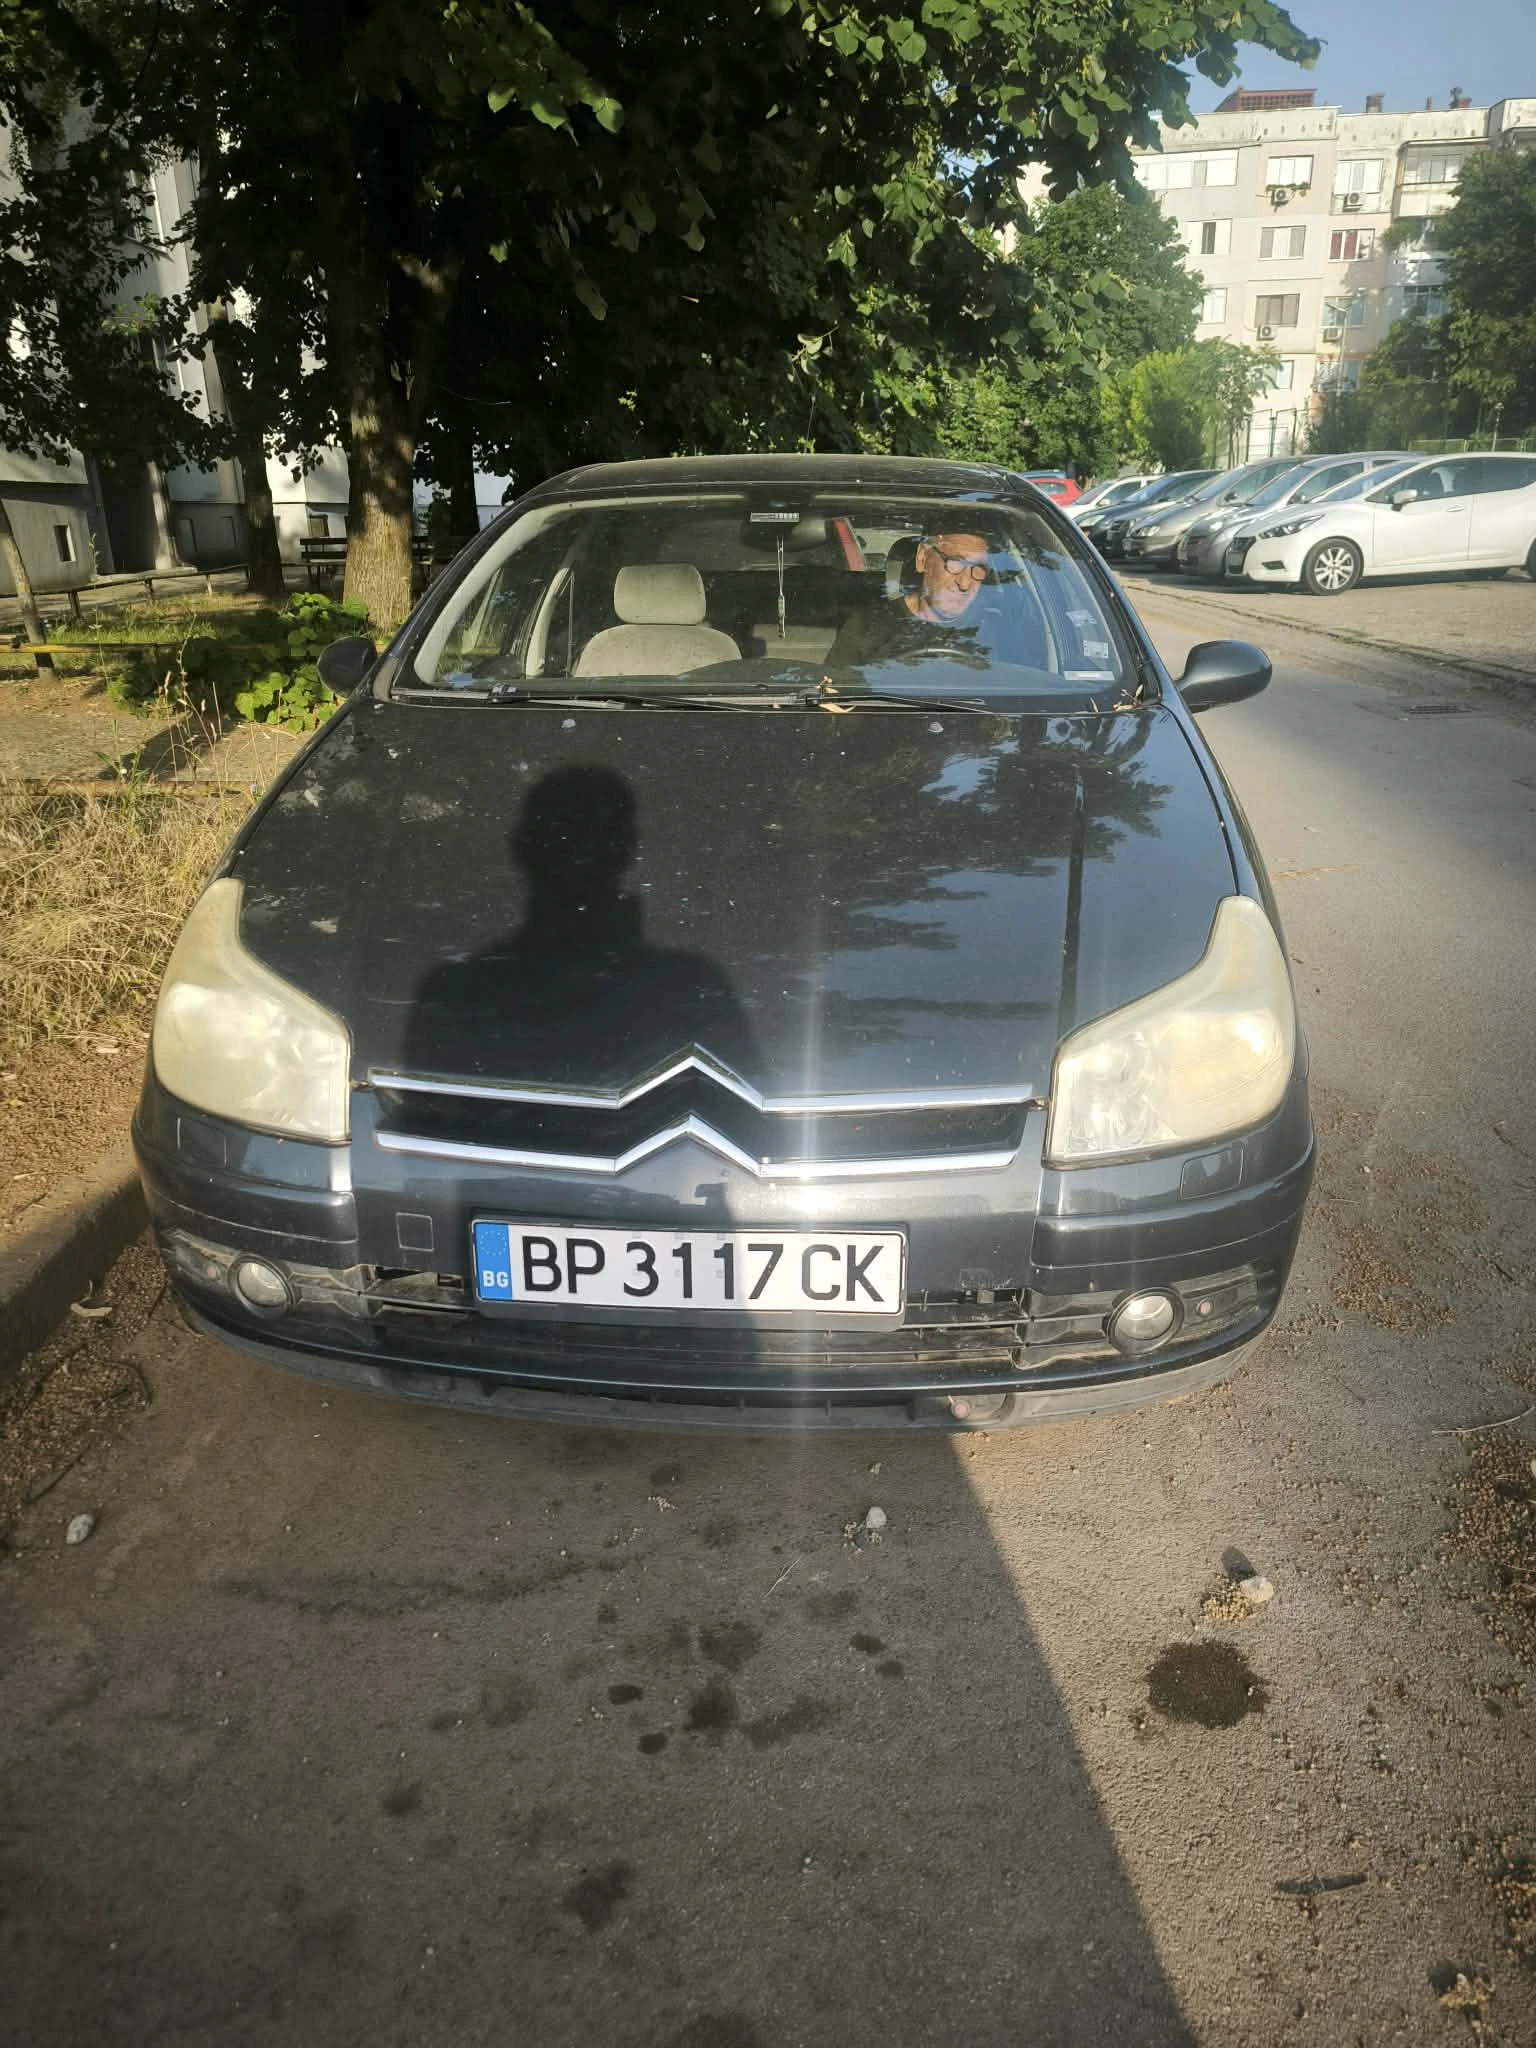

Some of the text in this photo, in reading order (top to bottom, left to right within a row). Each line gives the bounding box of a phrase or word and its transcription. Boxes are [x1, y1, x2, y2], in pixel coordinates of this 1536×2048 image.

[482, 1270, 509, 1289] BG
[521, 1235, 885, 1302] BP 3117 CK
